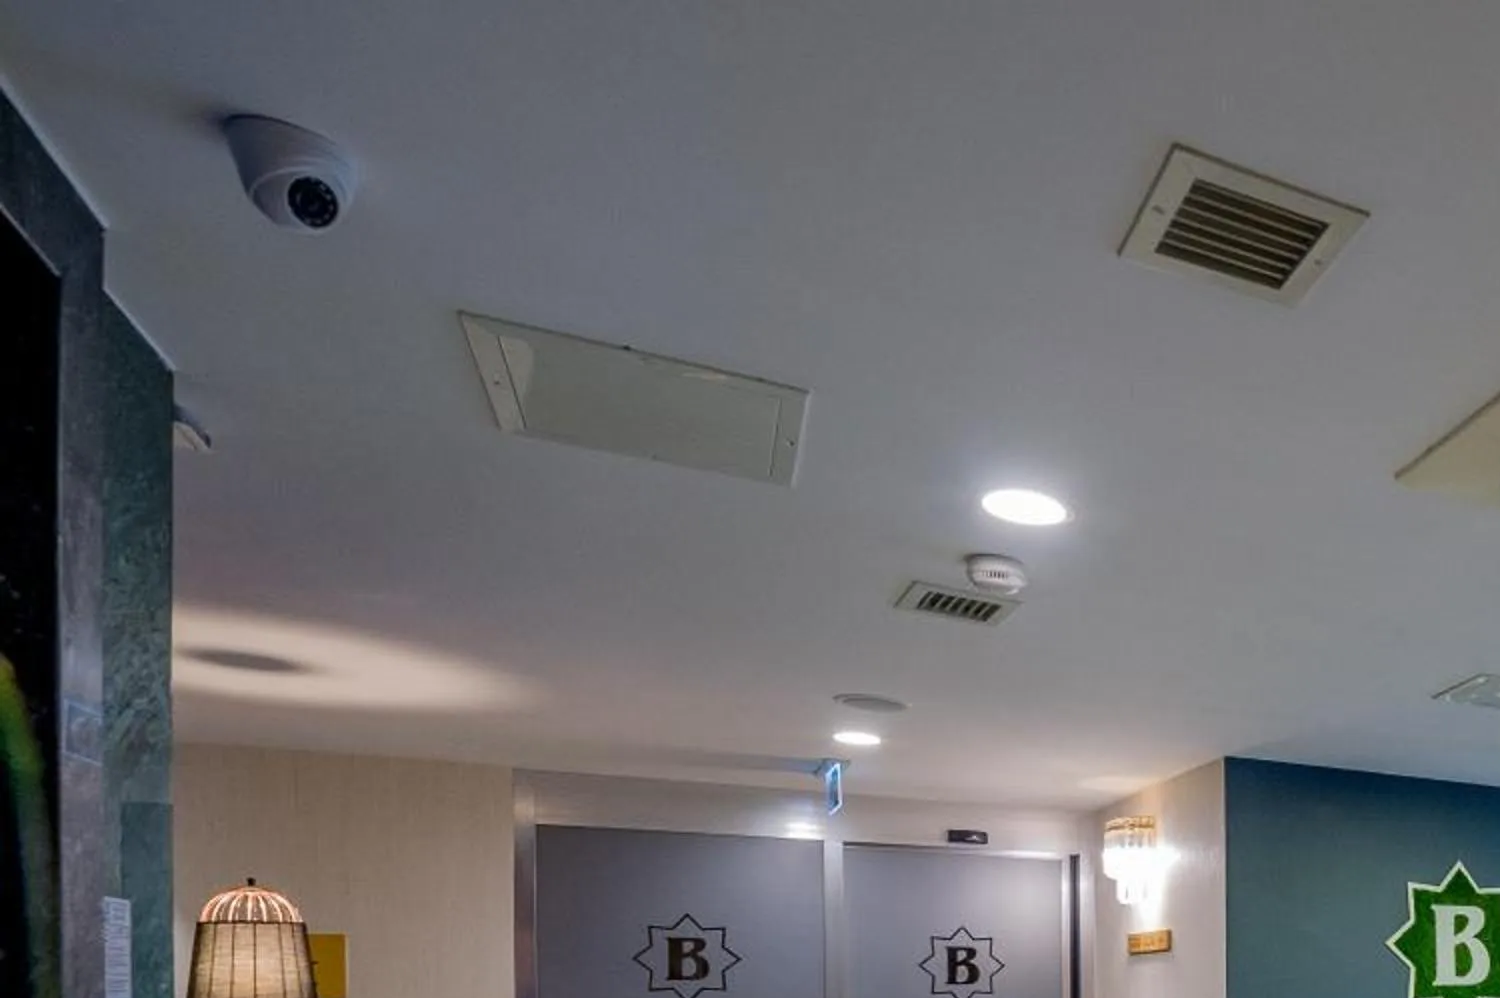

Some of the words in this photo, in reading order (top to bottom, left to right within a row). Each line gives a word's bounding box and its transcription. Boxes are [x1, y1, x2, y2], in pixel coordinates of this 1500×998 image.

[667, 937, 710, 981] B
[945, 946, 980, 985] B
[1431, 904, 1491, 986] B
